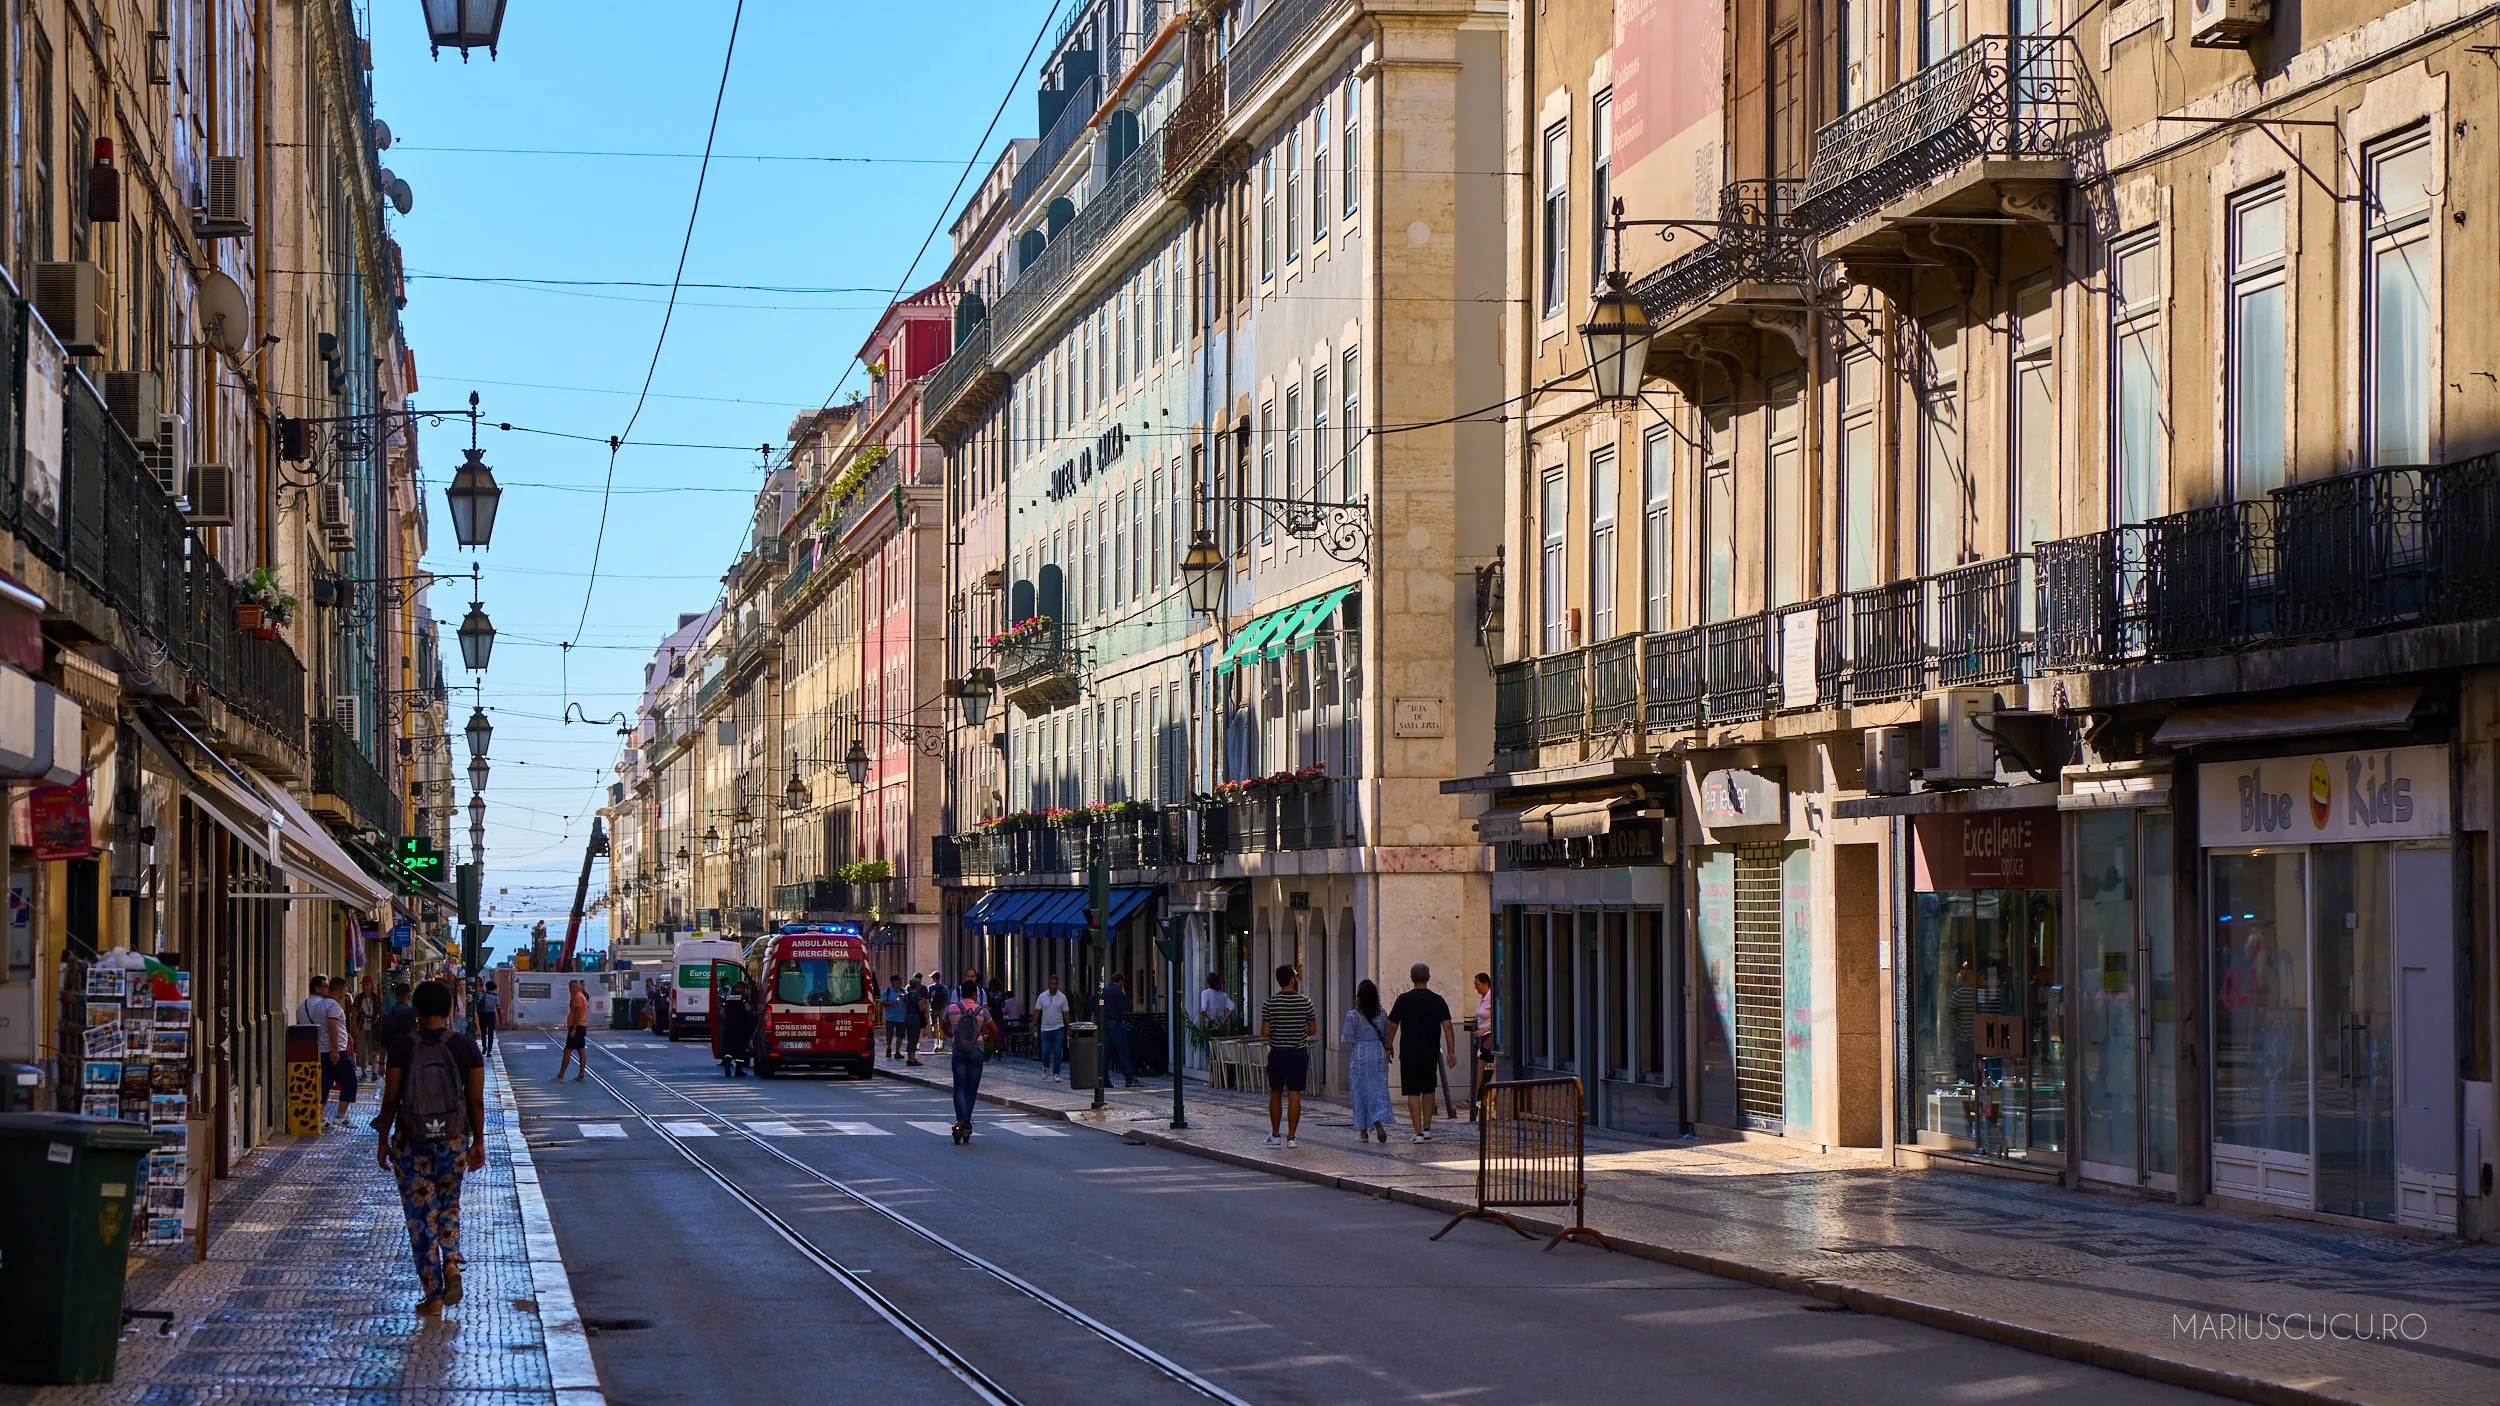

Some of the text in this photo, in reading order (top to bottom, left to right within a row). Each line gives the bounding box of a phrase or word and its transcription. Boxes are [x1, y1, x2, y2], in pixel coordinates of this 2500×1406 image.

[2238, 750, 2413, 832] Blue Kids
[1963, 816, 2023, 857] Excellent
[792, 939, 848, 947] AMBULÂNCIA
[792, 949, 849, 957] EMERGÊNCIA
[689, 970, 726, 978] Europar
